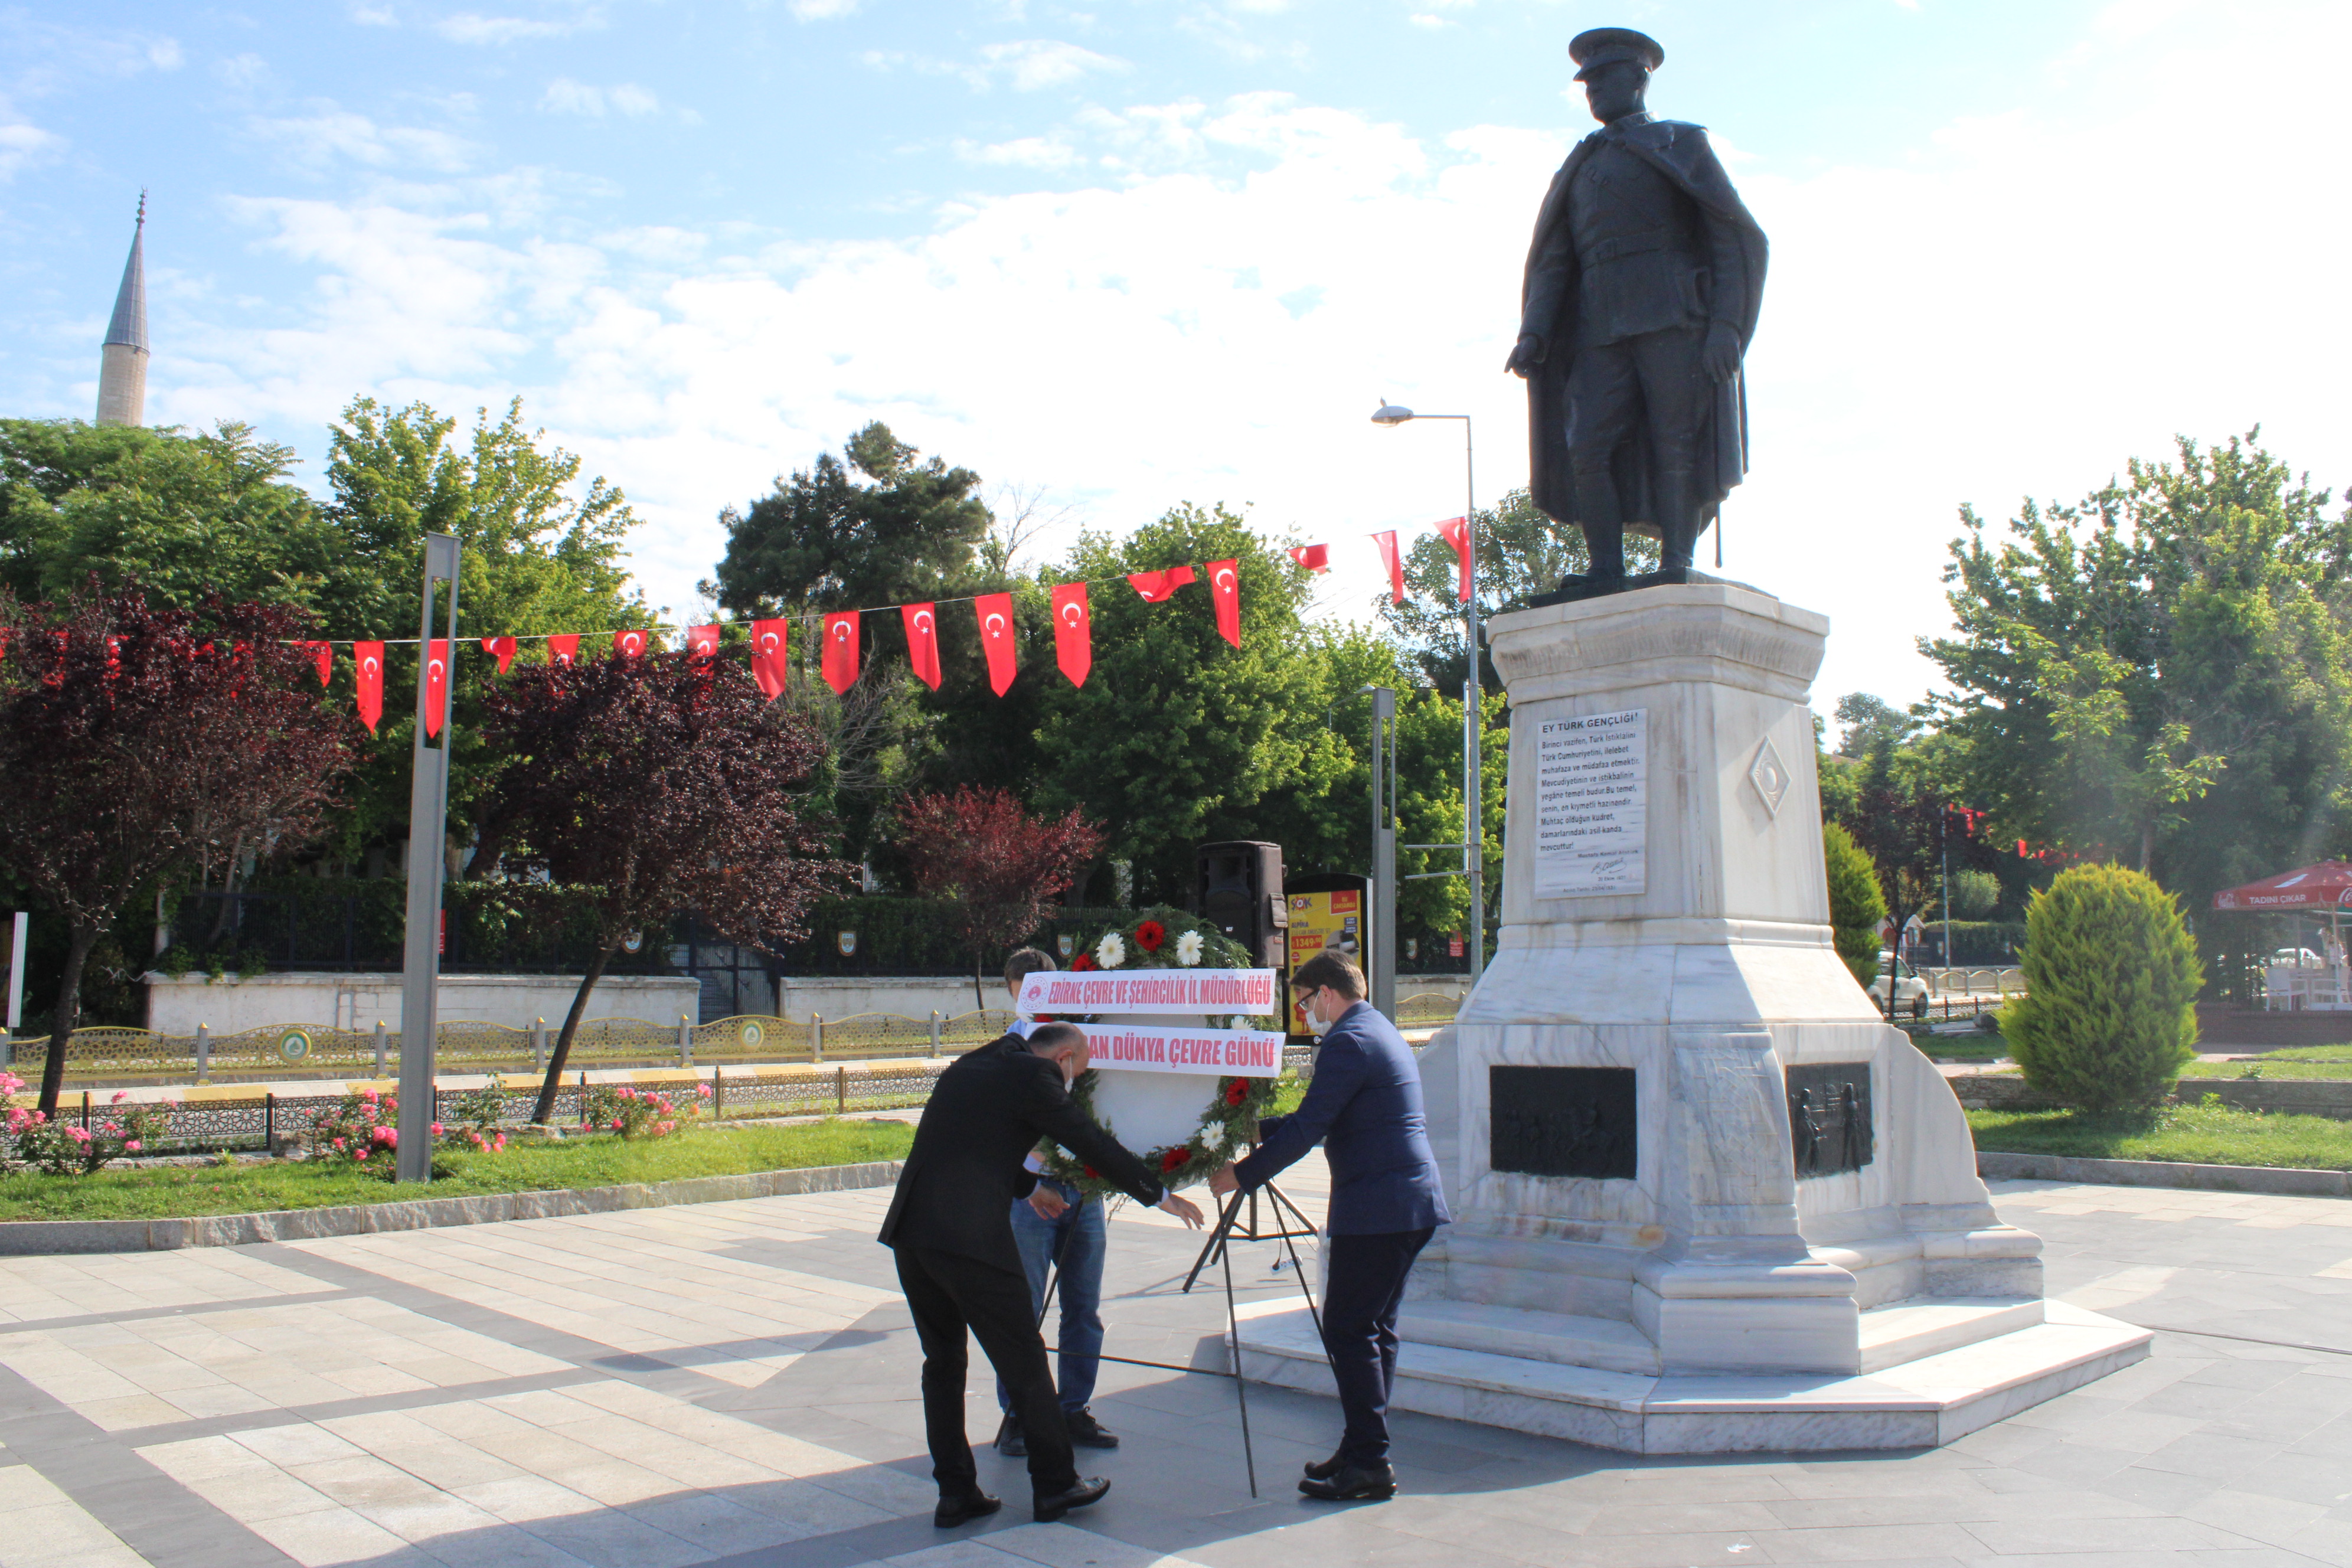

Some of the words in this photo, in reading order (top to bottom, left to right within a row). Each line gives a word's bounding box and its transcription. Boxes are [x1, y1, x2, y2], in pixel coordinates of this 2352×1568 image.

[1543, 724, 1554, 733] EY
[1558, 720, 1583, 731] TÜRK
[1587, 712, 1638, 727] GENÇLİĞİ!
[1542, 741, 1562, 749] Birinci
[1563, 737, 1587, 747] vazifen,
[1542, 753, 1556, 762] Türk
[1557, 749, 1603, 760] Cumhuriyetini,
[1604, 745, 1629, 755] ilelebet
[1541, 765, 1571, 775] muhafaza
[1582, 760, 1609, 770] müdafaa
[1611, 757, 1640, 767] etmektir.
[1541, 776, 1587, 788] Mevcudiyetinin
[1598, 771, 1634, 782] istikbalinin
[1541, 791, 1563, 802] yegâne
[1565, 788, 1585, 798] temeli
[1616, 783, 1636, 793] temel,
[1570, 800, 1596, 812] kıymetli
[1541, 817, 1563, 825] Muhtaç
[1565, 814, 1590, 824] olduğun
[1592, 812, 1615, 821] kudret,
[1540, 827, 1587, 838] damarlarındaki
[1589, 826, 1600, 834] asil
[1602, 825, 1622, 834] kanda
[1540, 842, 1574, 851] mevcuttur!
[1291, 896, 1312, 913] ŞOK
[2249, 895, 2278, 904] TADINI
[2280, 894, 2306, 904] ÇIKAR
[1048, 978, 1083, 1004] EDİRNE
[1083, 980, 1115, 1009] ÇEVRE
[1116, 980, 1128, 1004] VE
[1129, 975, 1187, 1009] ŞEHİRCİLİK
[1188, 975, 1198, 1004] İL
[1200, 975, 1271, 1005] MÜDÜRLÜĞÜ
[1113, 1032, 1165, 1063] DÜNYA
[1169, 1038, 1222, 1069] ÇEVRE
[1225, 1036, 1275, 1067] GÜNÜ
